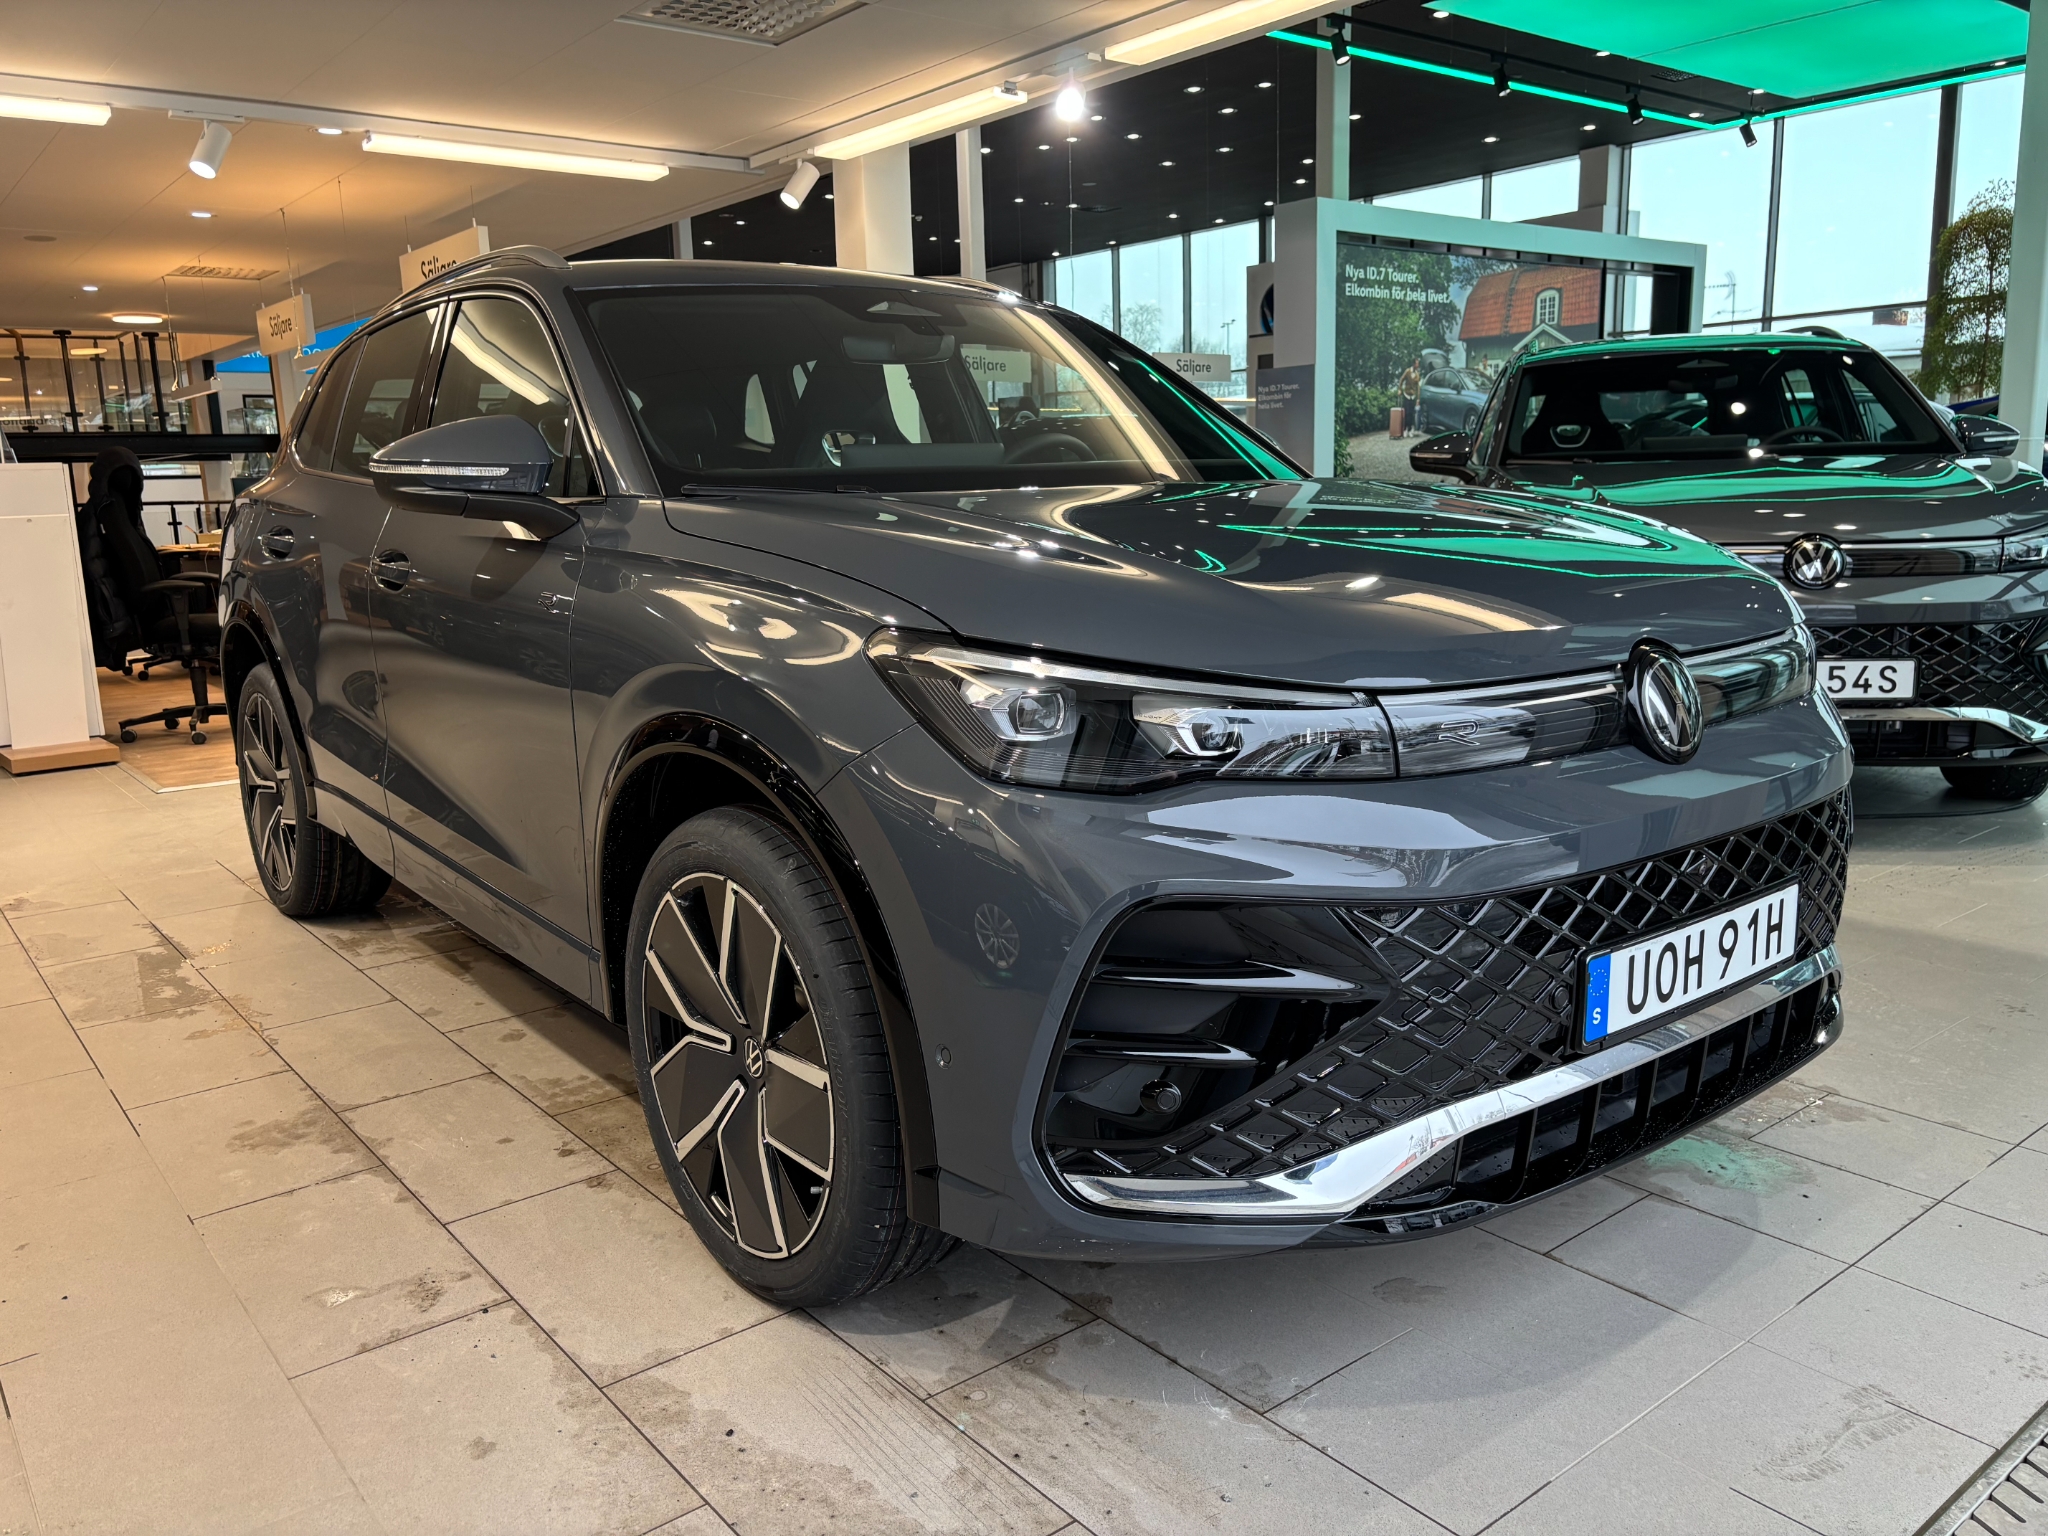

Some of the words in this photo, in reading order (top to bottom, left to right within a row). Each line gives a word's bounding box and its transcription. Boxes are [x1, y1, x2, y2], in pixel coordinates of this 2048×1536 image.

[1345, 264, 1365, 281] Nya
[1366, 266, 1386, 281] ID.7
[1387, 268, 1419, 284] Tourer.
[1345, 283, 1390, 300] Elkombin
[1391, 285, 1406, 300] för
[1406, 287, 1426, 302] hela
[268, 313, 293, 340] Säljare
[964, 355, 1007, 375] Säljare
[1176, 358, 1212, 376] Säljare
[1826, 665, 1898, 694] 54S
[1627, 928, 1705, 1015] UOH
[1718, 897, 1785, 981] 91H
[1592, 1007, 1602, 1025] S
